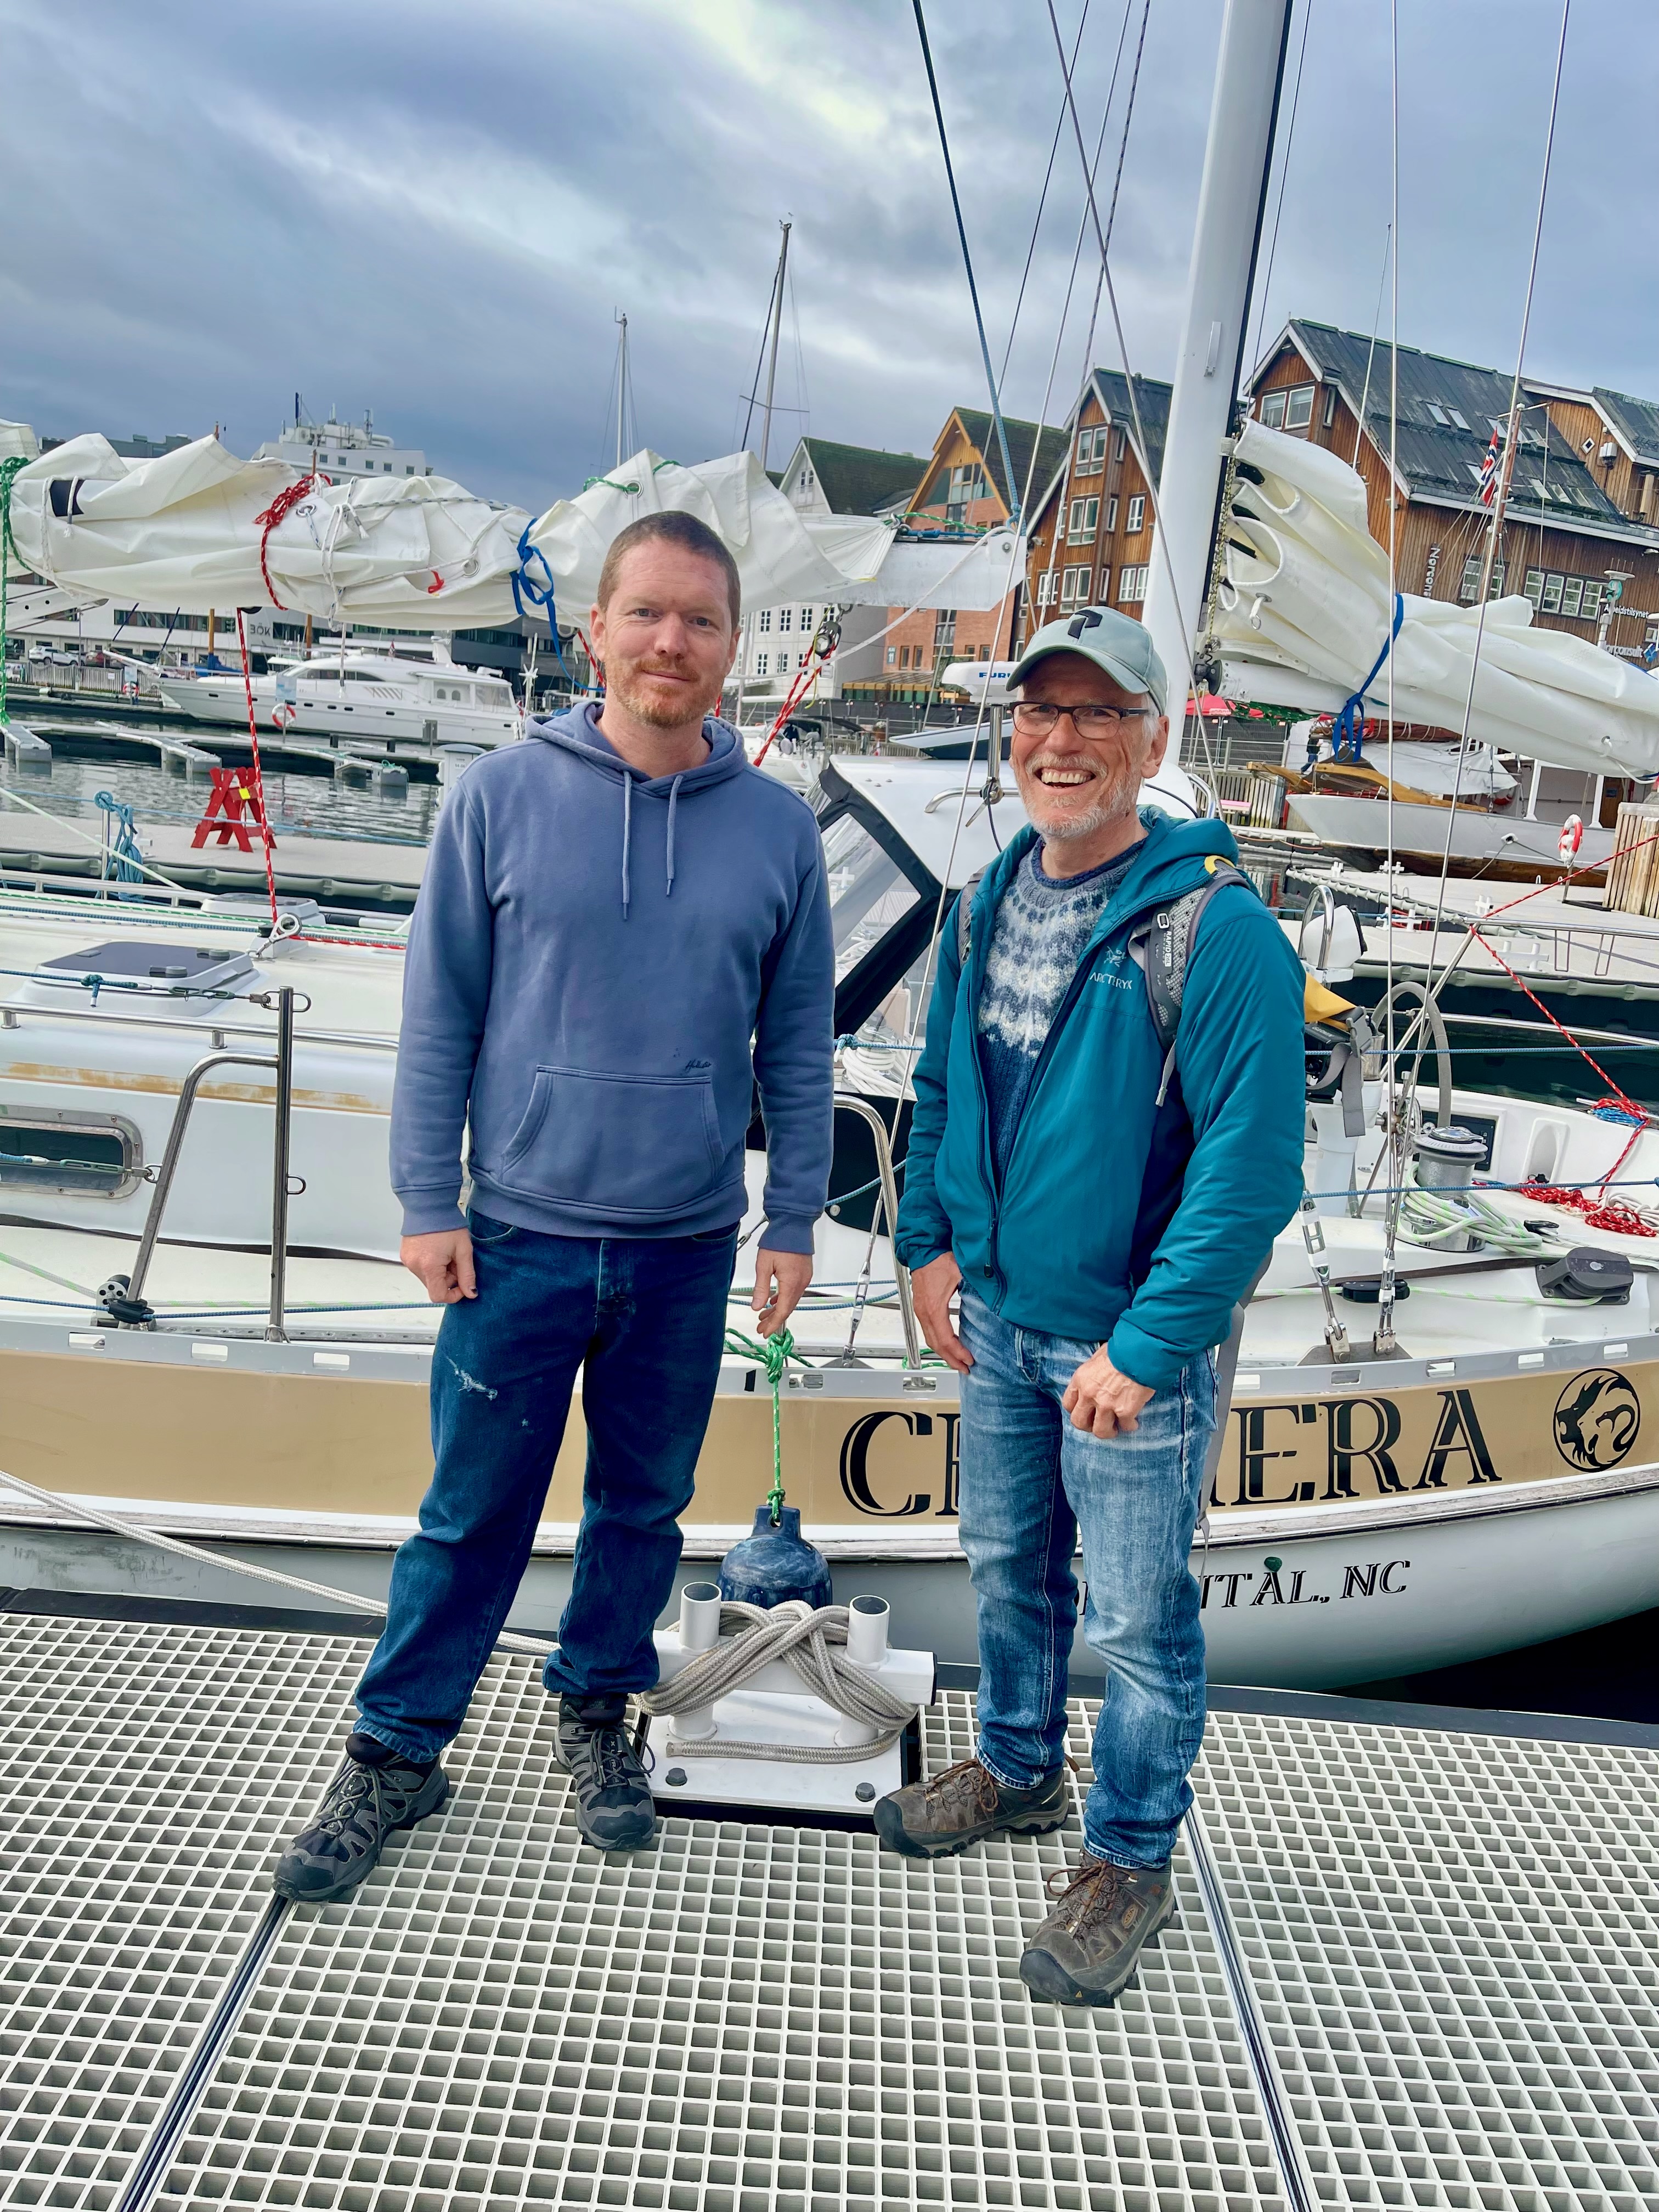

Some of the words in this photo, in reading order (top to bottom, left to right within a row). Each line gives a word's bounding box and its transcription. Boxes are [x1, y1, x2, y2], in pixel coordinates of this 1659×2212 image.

[1424, 548, 1441, 599] Norcons
[1604, 603, 1649, 619] Aeidstilsynet
[1606, 645, 1643, 658] orconsult
[839, 1389, 1502, 1516] CERA
[1339, 1561, 1410, 1599] NC
